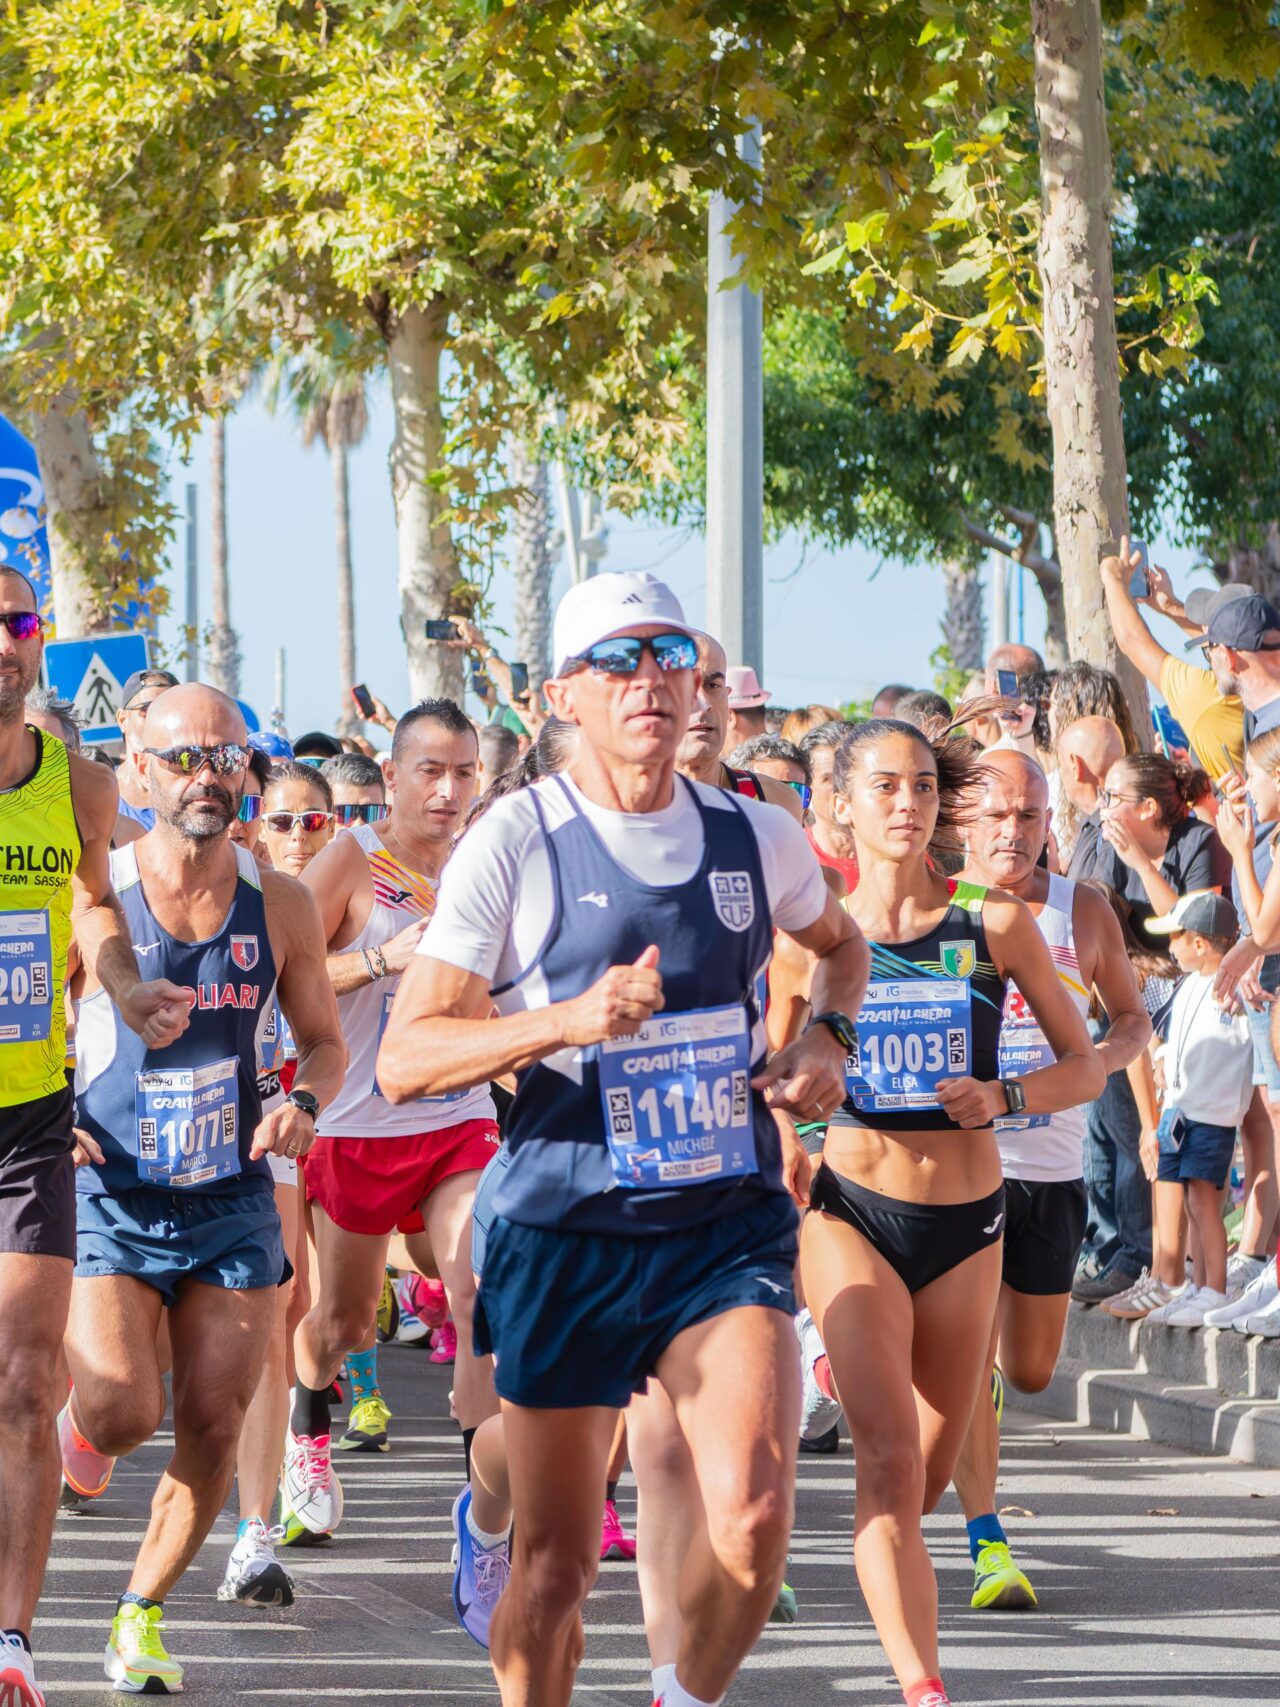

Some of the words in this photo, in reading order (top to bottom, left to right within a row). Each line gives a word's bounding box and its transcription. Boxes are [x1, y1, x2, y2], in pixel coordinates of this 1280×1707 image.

[721, 904, 751, 927] CUS
[856, 1009, 891, 1023] CRAI
[899, 1007, 952, 1020] ALGHERO
[622, 1053, 671, 1075] CRAI
[863, 1032, 945, 1075] 1003
[1000, 1050, 1042, 1061] ALGHERO
[892, 1076, 918, 1089] ELISA
[152, 1096, 186, 1110] CRAI
[193, 1086, 225, 1106] ALGHERO
[637, 1076, 731, 1138] 1146
[160, 1110, 220, 1157] 1077
[667, 1135, 716, 1155] MICHELE
[182, 1153, 208, 1170] MARCO
